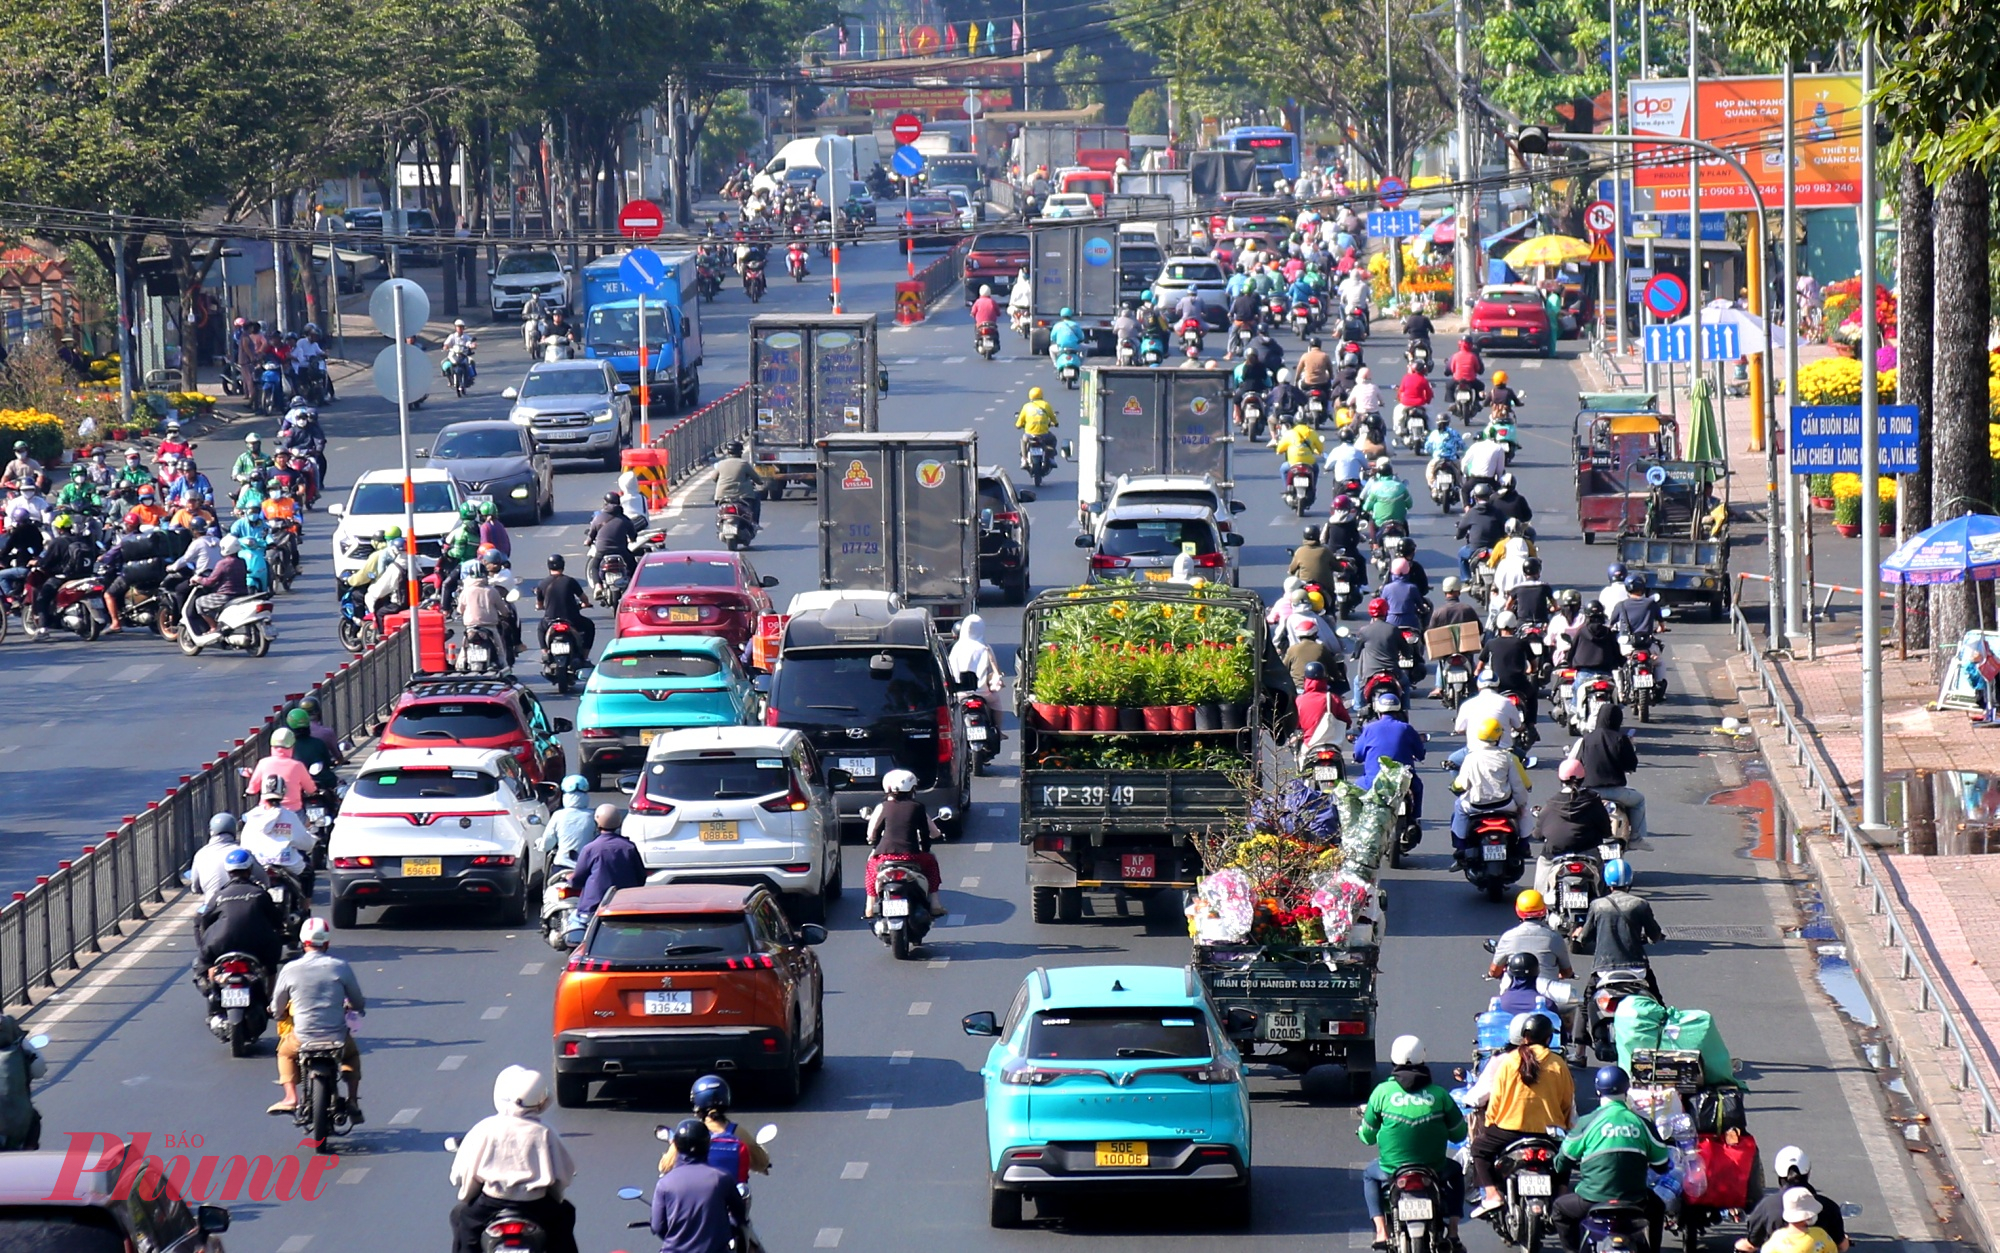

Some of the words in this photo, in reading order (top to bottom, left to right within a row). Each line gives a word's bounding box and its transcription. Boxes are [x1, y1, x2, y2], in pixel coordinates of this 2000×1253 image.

[1715, 99, 1735, 109] HỘP
[1724, 108, 1757, 118] QUẢNG
[1760, 107, 1779, 115] CÁO
[1822, 145, 1846, 154] THIẾT
[1814, 155, 1846, 165] QUẢNG
[1707, 169, 1732, 177] PLANT
[1661, 187, 1708, 199] HOTLIE:
[1710, 186, 1735, 196] 0906
[1738, 185, 1755, 195] 33
[1814, 183, 1832, 192] 982
[1835, 182, 1853, 192] 246
[1801, 412, 1819, 436] CẤM
[1820, 413, 1842, 435] BUÔN
[1843, 412, 1860, 435] BÁN
[1890, 415, 1913, 435] RONG
[1792, 442, 1808, 466] LẤN
[1809, 442, 1834, 466] CHIẾM
[1837, 442, 1859, 466] LÒNG
[1906, 441, 1918, 465] HÈ
[850, 524, 870, 537] 51C
[849, 759, 865, 767] 51L
[709, 822, 727, 831] 50E
[1131, 855, 1145, 866] KP
[1124, 866, 1152, 877] 39-49
[1300, 980, 1316, 988] 033
[1318, 980, 1329, 988] 22
[1330, 980, 1347, 988] 777
[658, 992, 678, 1002] 51K
[650, 1002, 687, 1014] 336.42
[1274, 1015, 1298, 1027] 50TD
[1269, 1028, 1301, 1039] 020.05
[1390, 1089, 1436, 1107] Grab
[1601, 1122, 1641, 1139] Grab
[1110, 1142, 1133, 1154] 50E
[1103, 1154, 1143, 1165] 100.06
